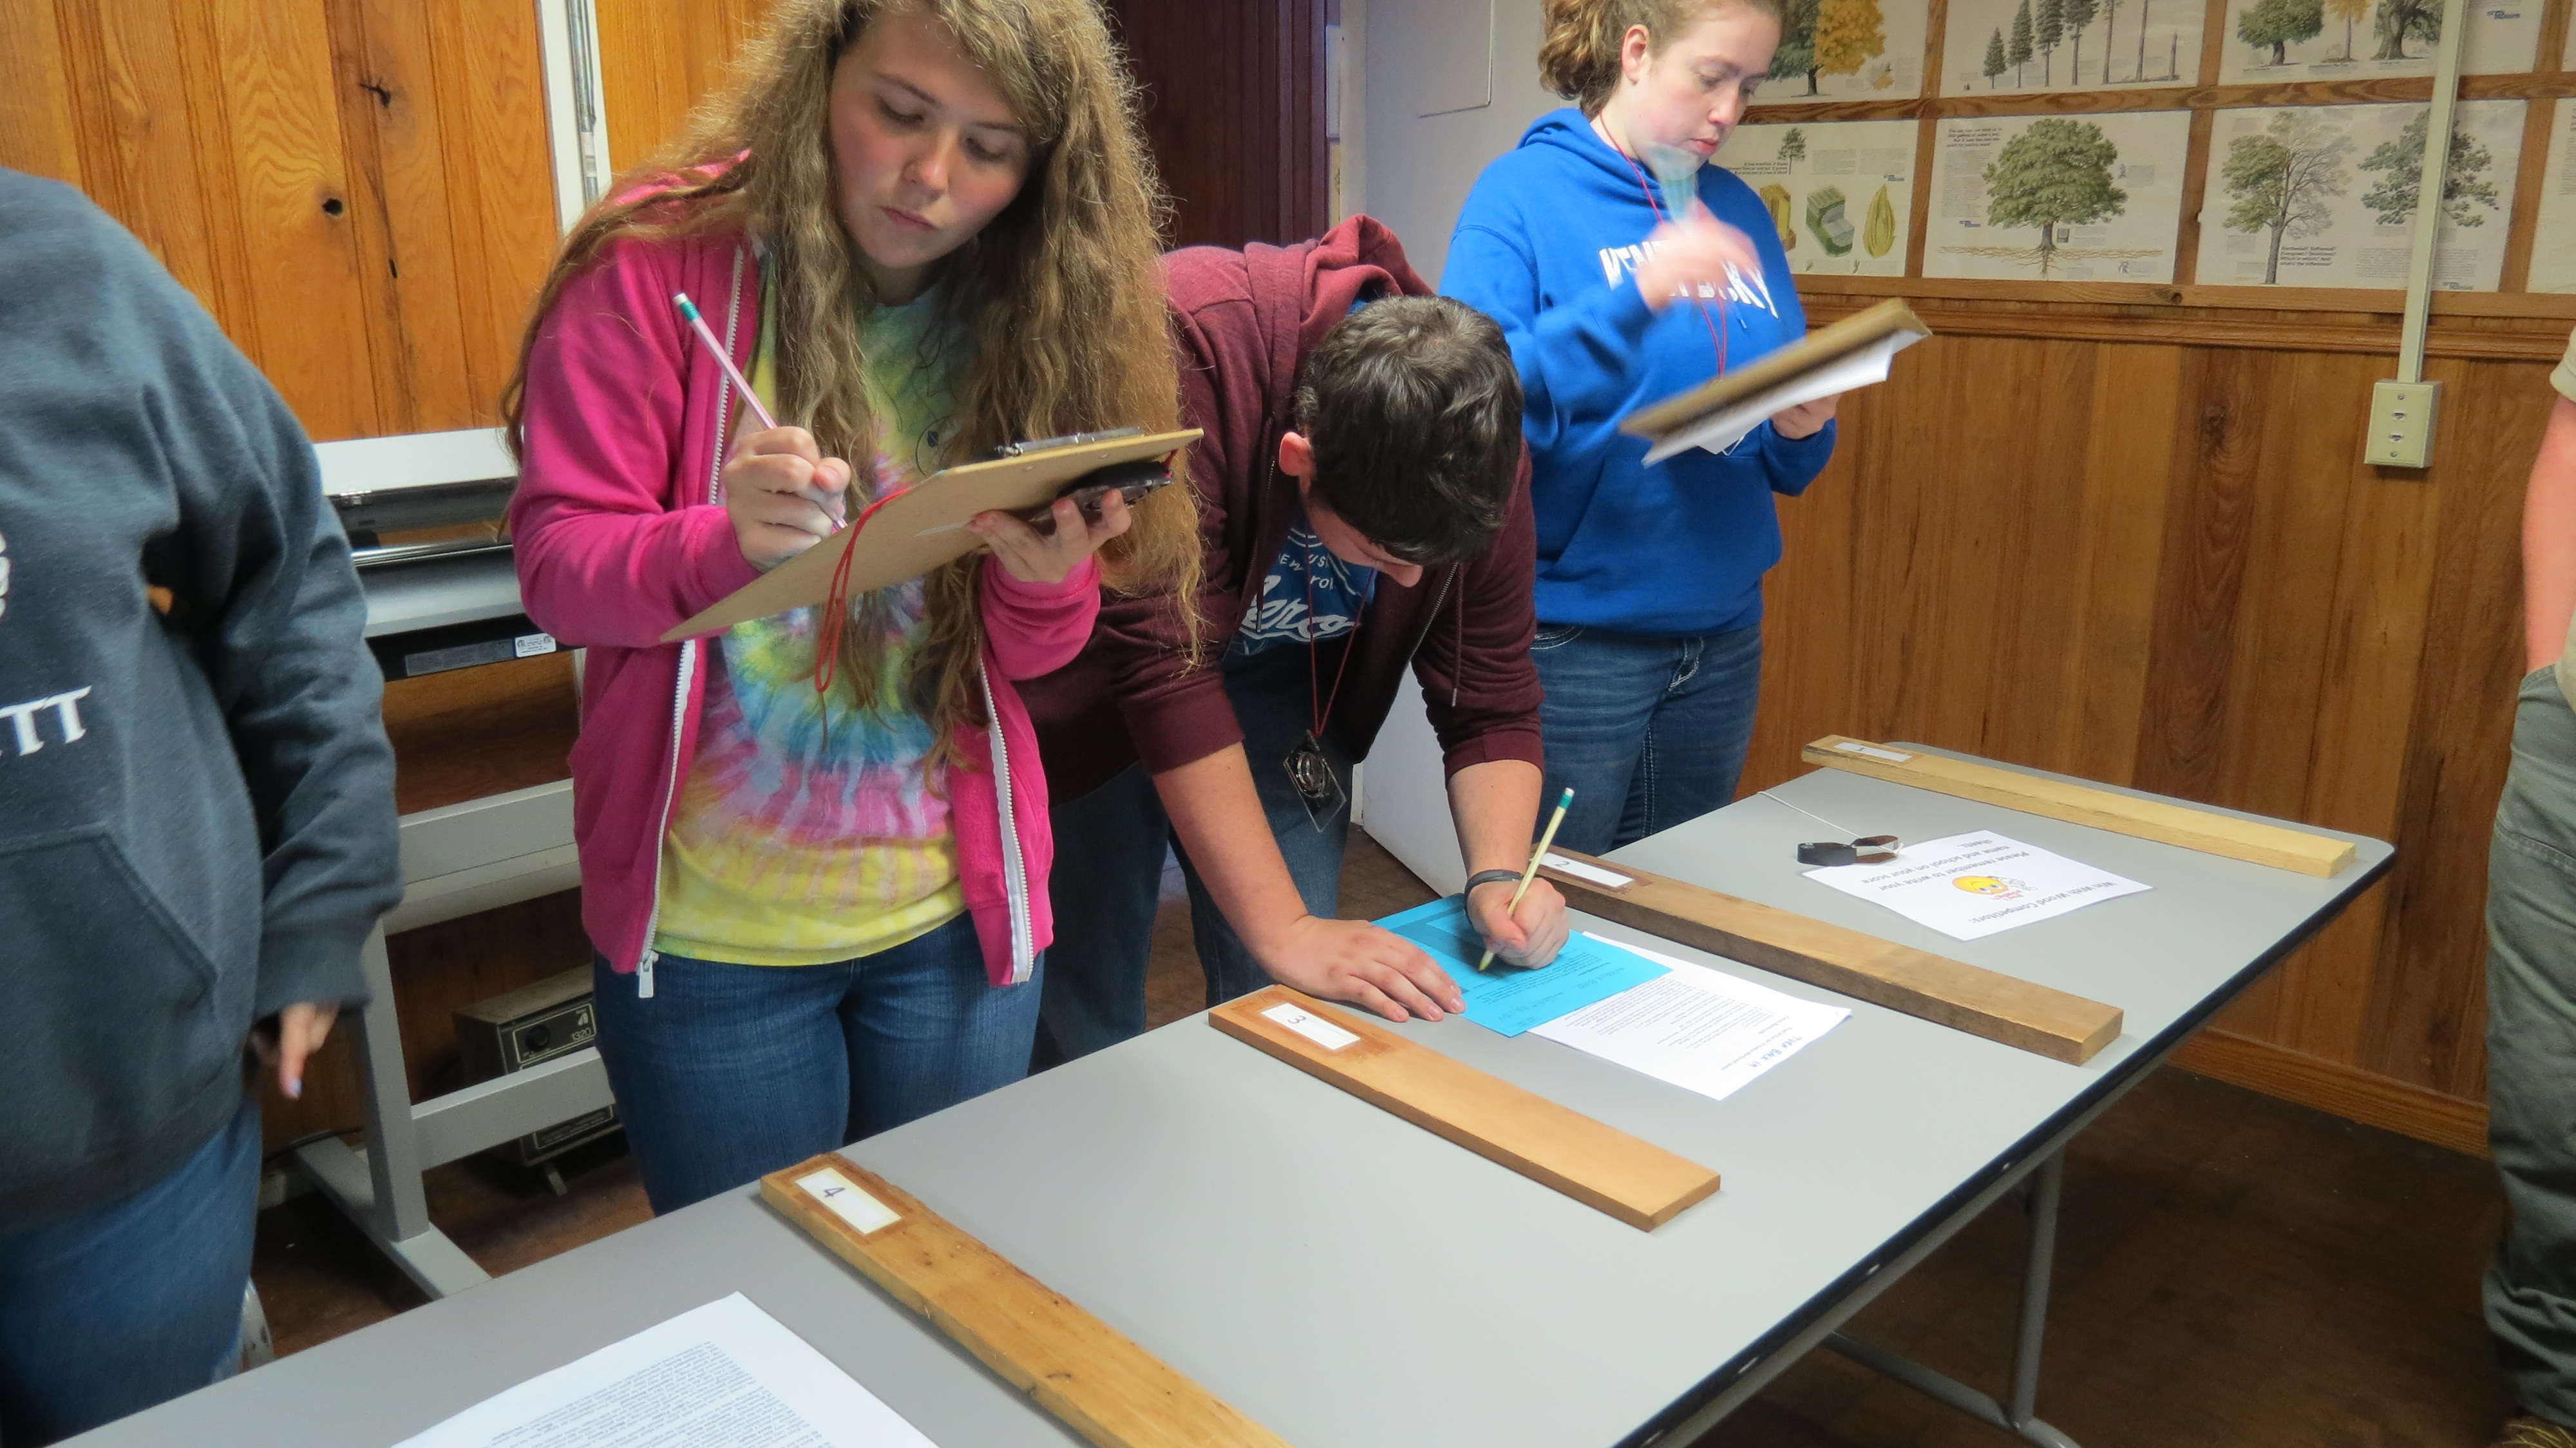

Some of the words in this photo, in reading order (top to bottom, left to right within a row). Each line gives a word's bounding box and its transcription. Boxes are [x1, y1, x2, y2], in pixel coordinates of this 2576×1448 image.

[0, 684, 92, 756] TT
[1963, 849, 1981, 859] and
[1983, 844, 2011, 854] name
[1931, 855, 1963, 868] school
[1997, 851, 2031, 862] Please
[1891, 866, 1914, 878] your
[1915, 864, 1929, 872] on
[1946, 859, 1996, 875] remember
[1861, 874, 1890, 884] score
[1906, 873, 1931, 885] write
[1880, 880, 1904, 891] your
[2069, 886, 2093, 895] With
[2036, 891, 2071, 906] Wood
[1969, 902, 2038, 923] Competitors:
[1287, 1015, 1306, 1024] 3
[824, 1187, 846, 1198] 4
